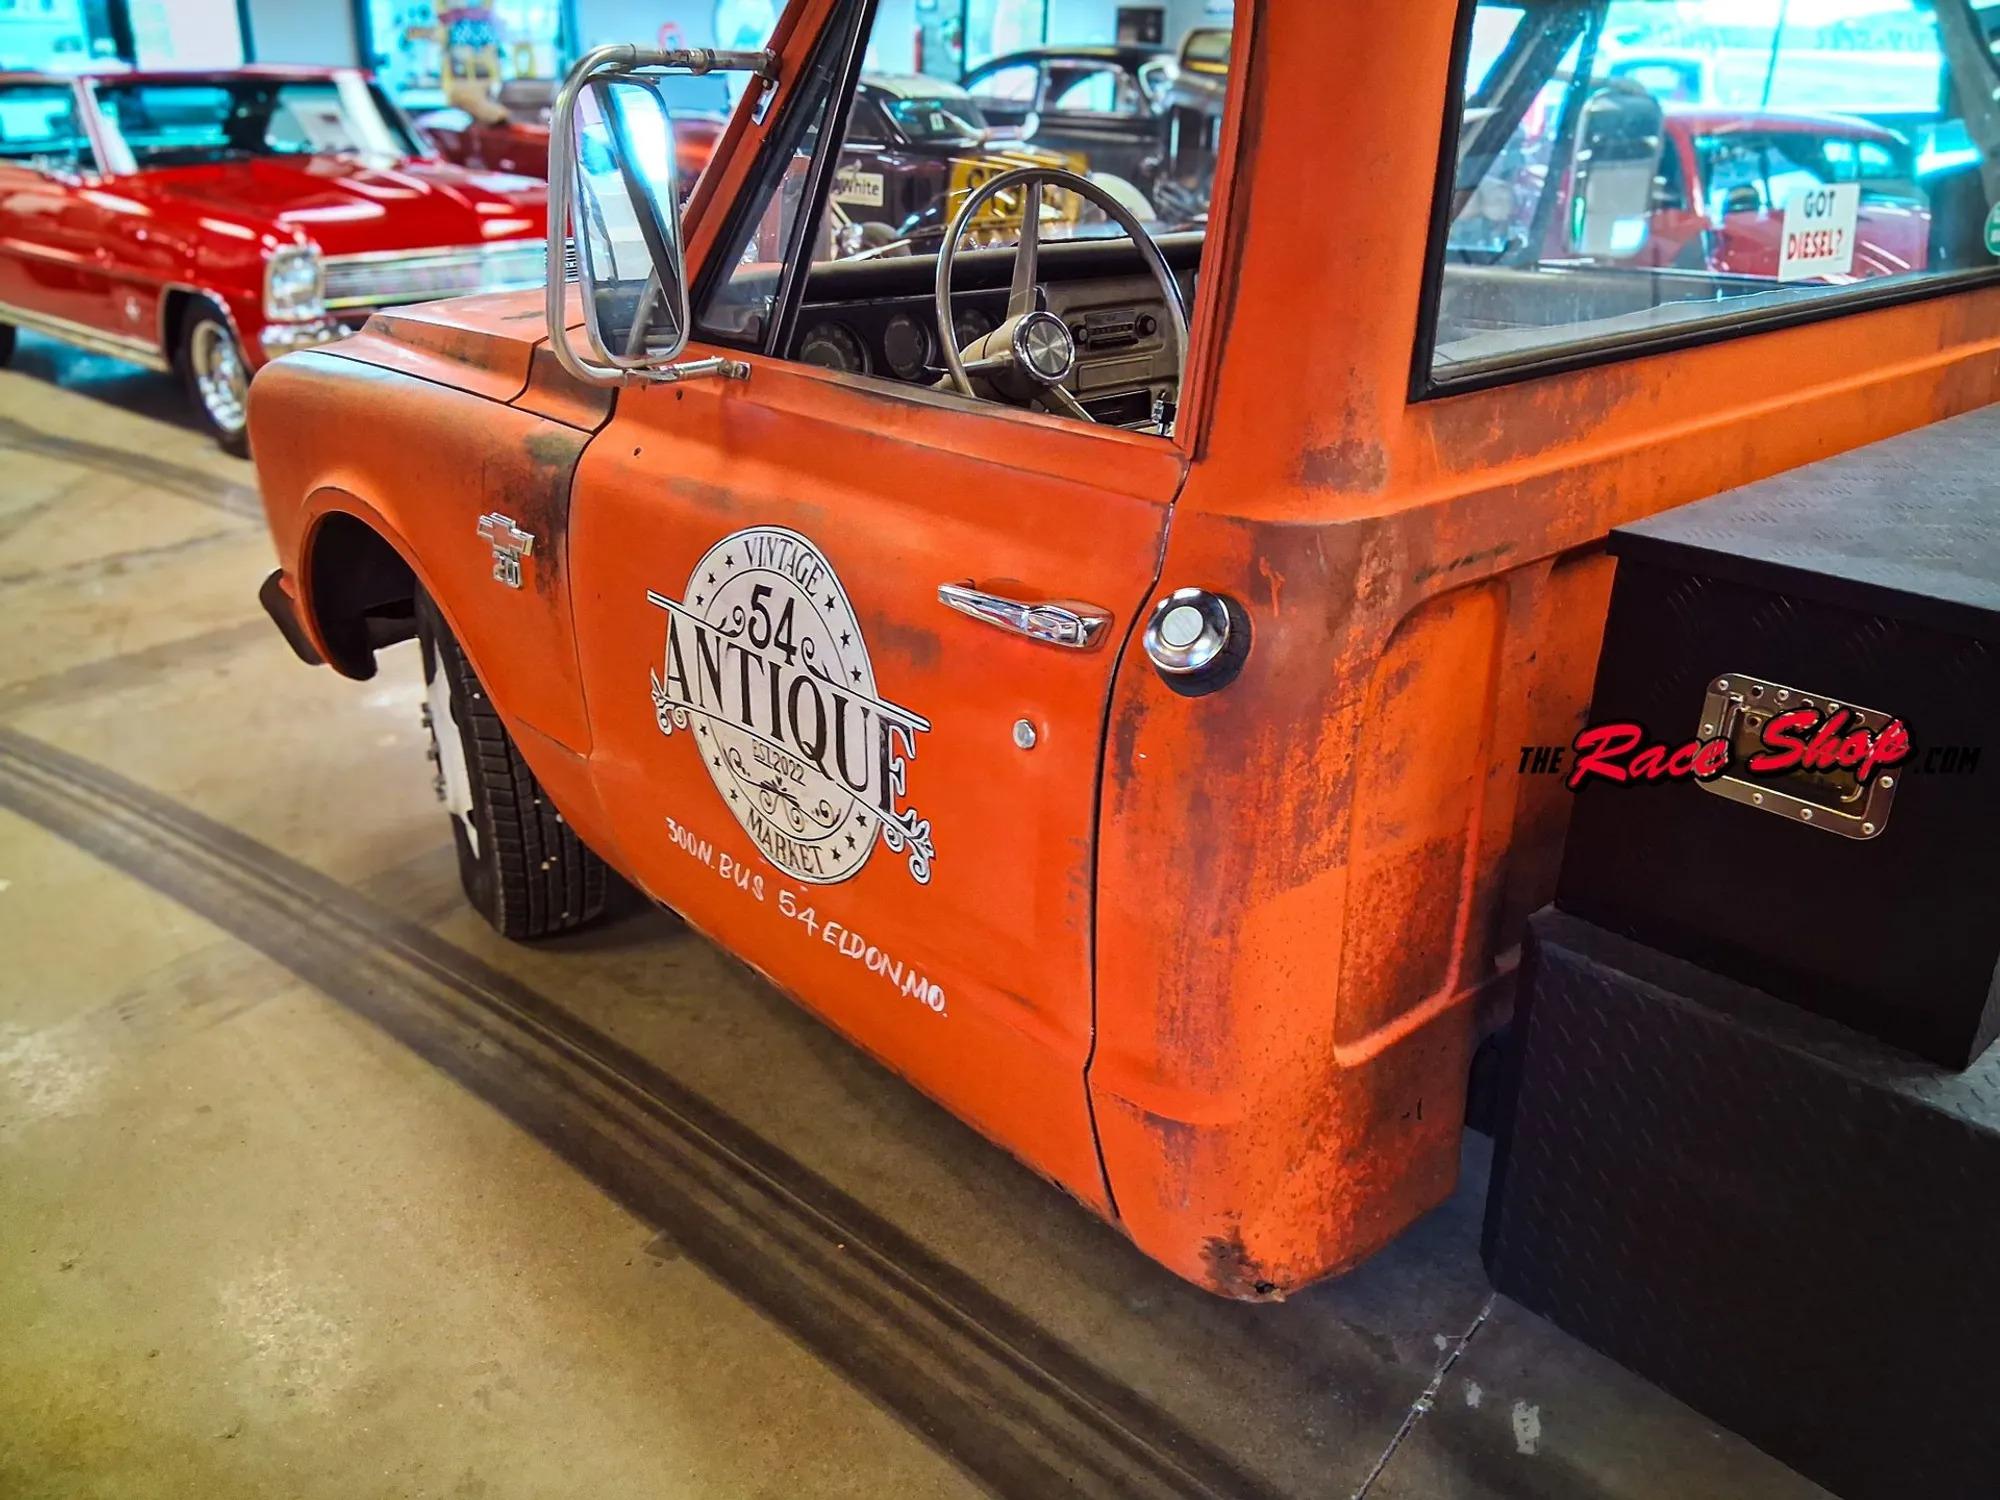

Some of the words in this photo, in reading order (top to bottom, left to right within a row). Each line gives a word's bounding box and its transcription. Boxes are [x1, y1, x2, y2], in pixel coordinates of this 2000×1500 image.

[1803, 191, 1836, 218] GOT
[1787, 229, 1843, 260] DIESEL?
[744, 537, 824, 596] VINTAGE
[750, 584, 797, 666] 54
[664, 613, 916, 814] ANTIQUE
[746, 808, 823, 874] MARKET
[719, 853, 764, 902] BUS
[779, 889, 818, 935] 54
